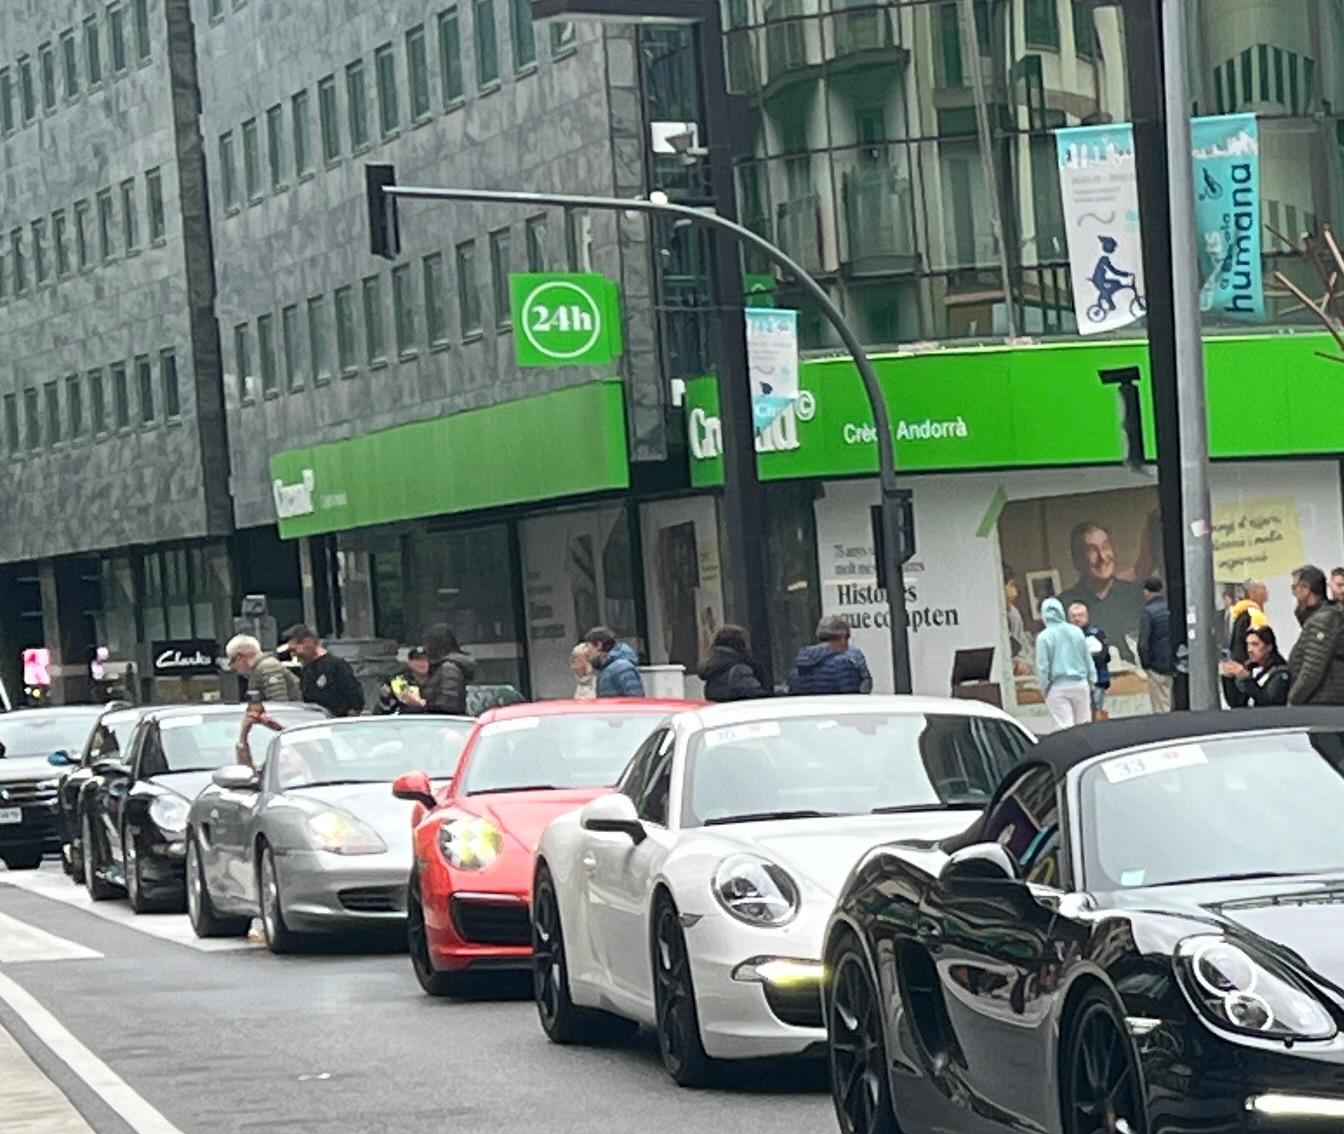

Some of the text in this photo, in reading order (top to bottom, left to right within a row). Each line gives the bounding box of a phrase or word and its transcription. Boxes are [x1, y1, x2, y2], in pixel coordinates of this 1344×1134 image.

[1223, 163, 1255, 313] humana
[531, 305, 592, 332] 24h
[897, 416, 968, 440] Andorrà
[156, 650, 211, 668] Clarks
